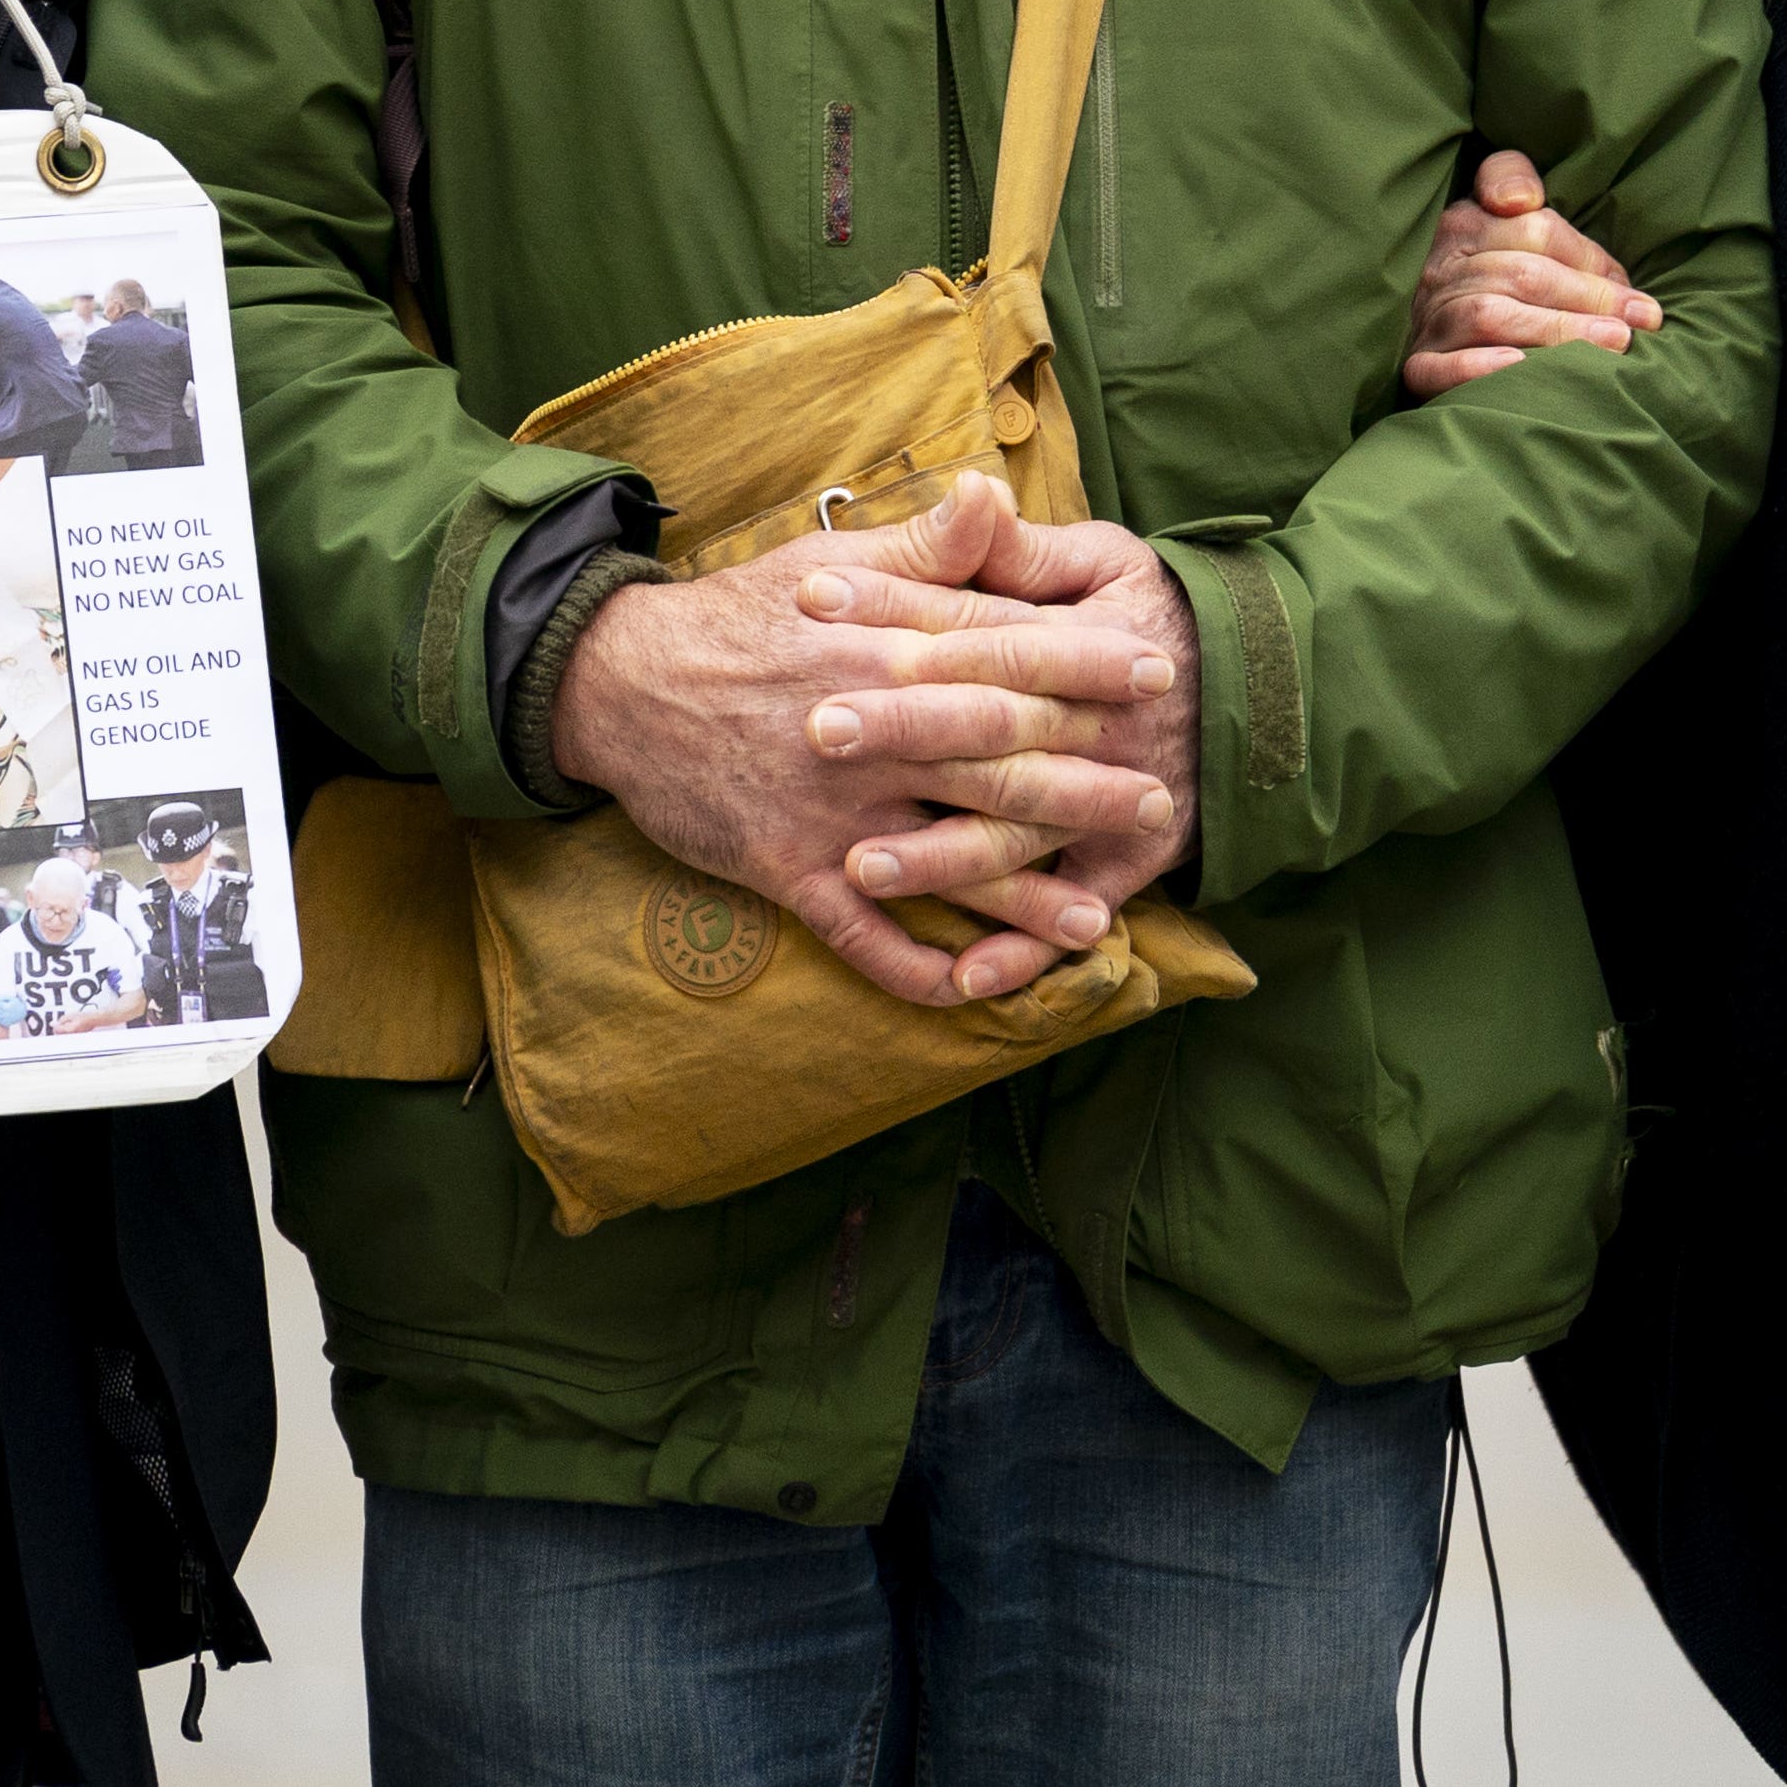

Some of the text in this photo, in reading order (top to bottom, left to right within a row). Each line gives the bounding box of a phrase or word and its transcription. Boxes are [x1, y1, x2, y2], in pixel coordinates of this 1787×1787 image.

[68, 518, 212, 546] NO NEW OIL
[71, 550, 225, 579] NO NEW GAS
[75, 582, 244, 613] NO NEW COAL
[83, 649, 241, 680] NEW OIL AND
[86, 690, 159, 713] GAS IS
[90, 719, 212, 746] GENOCIDE
[690, 903, 718, 946] F
